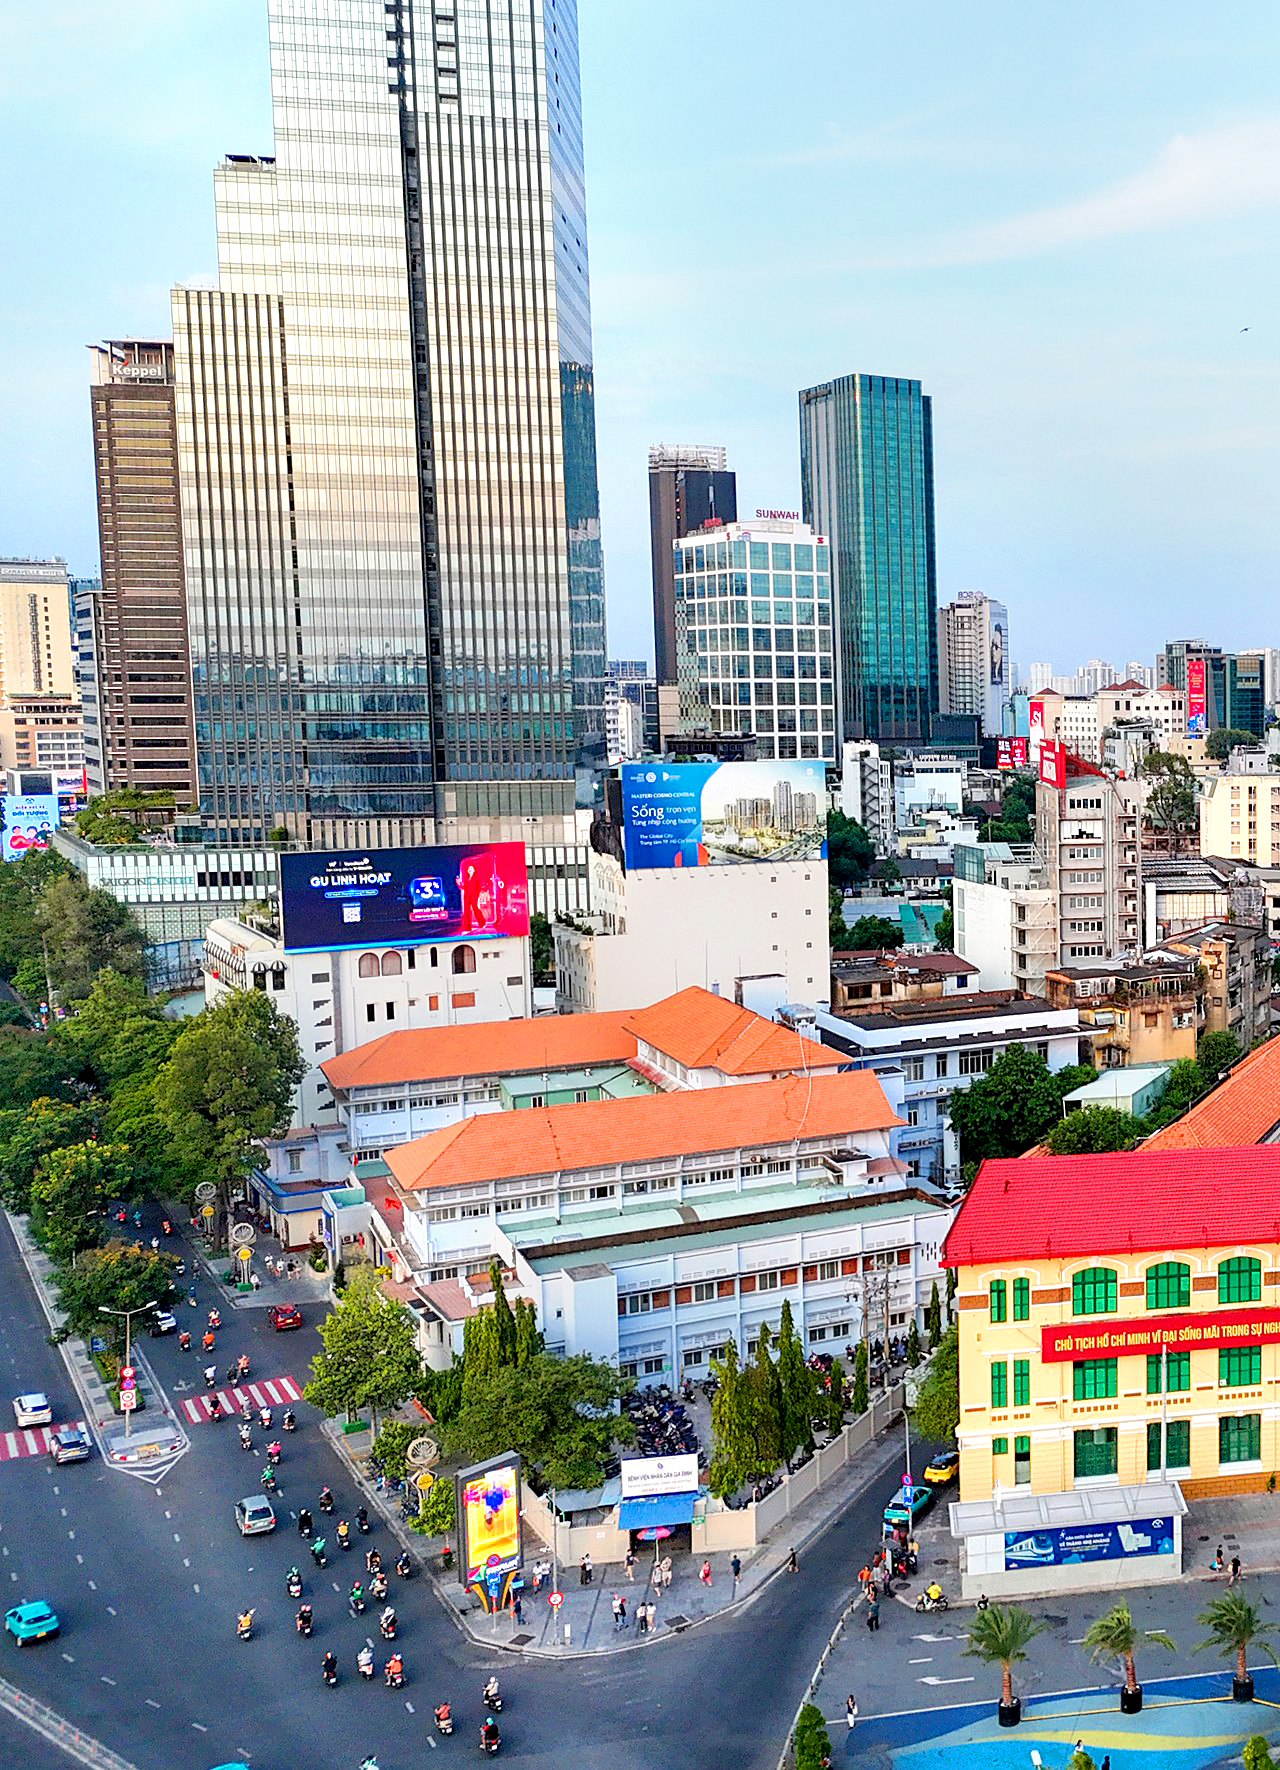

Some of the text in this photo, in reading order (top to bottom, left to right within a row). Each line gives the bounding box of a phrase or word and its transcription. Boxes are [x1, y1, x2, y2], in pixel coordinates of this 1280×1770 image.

[113, 365, 161, 377] Keppel
[756, 509, 799, 520] SUNWAH
[631, 803, 664, 819] Sống
[310, 872, 391, 887] GU LINH HOẠT
[1055, 1335, 1073, 1351] CHỦ
[1075, 1336, 1095, 1352] TỊCH
[1096, 1332, 1109, 1348] HỒ
[1110, 1331, 1126, 1347] CHÍ
[1127, 1332, 1150, 1345] MINH
[1151, 1329, 1161, 1343] VĨ
[1162, 1330, 1177, 1345] ĐẠI
[1179, 1325, 1202, 1340] SỐNG
[1203, 1325, 1220, 1339] MÃI
[1221, 1323, 1250, 1338] TRONG
[1251, 1322, 1262, 1337] SỰ
